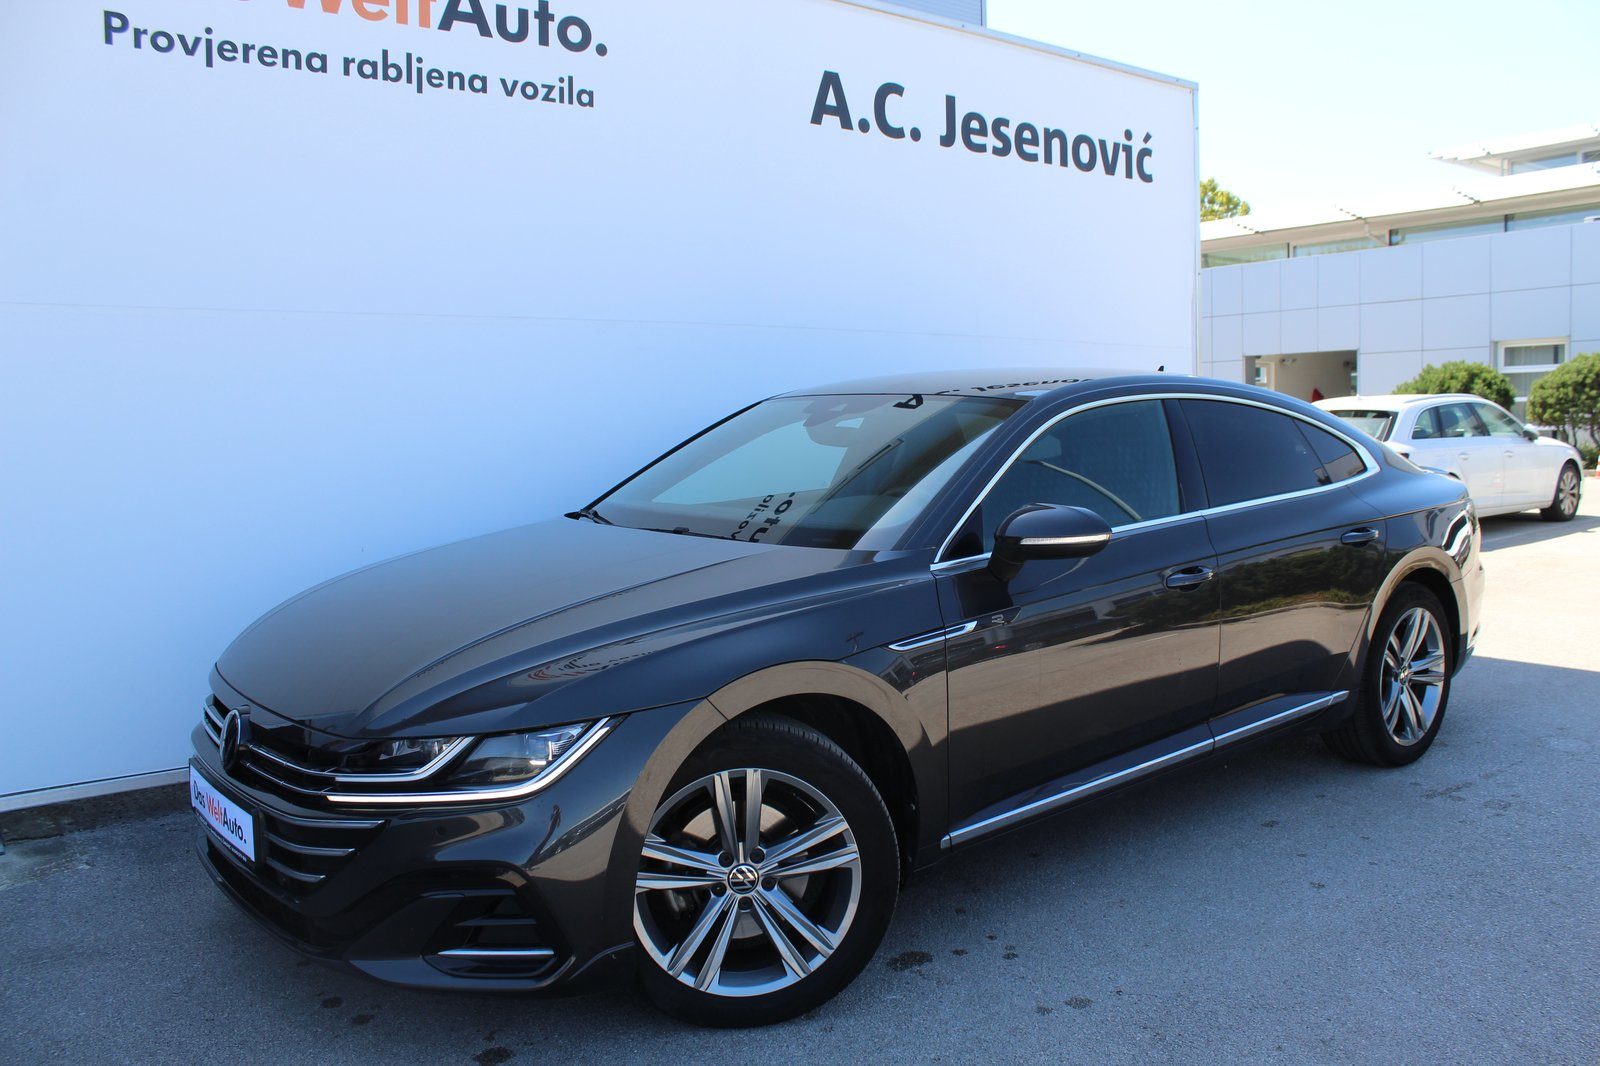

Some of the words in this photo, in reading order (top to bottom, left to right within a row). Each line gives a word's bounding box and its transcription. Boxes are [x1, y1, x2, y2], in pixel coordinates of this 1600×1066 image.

[103, 9, 329, 75] Provjerena
[342, 49, 488, 95] rabljena
[499, 76, 595, 108] vozila
[809, 69, 922, 143] A.C.
[939, 94, 1154, 184] Jesenović
[193, 780, 206, 808] Das
[206, 792, 247, 844] WeltAuto.
